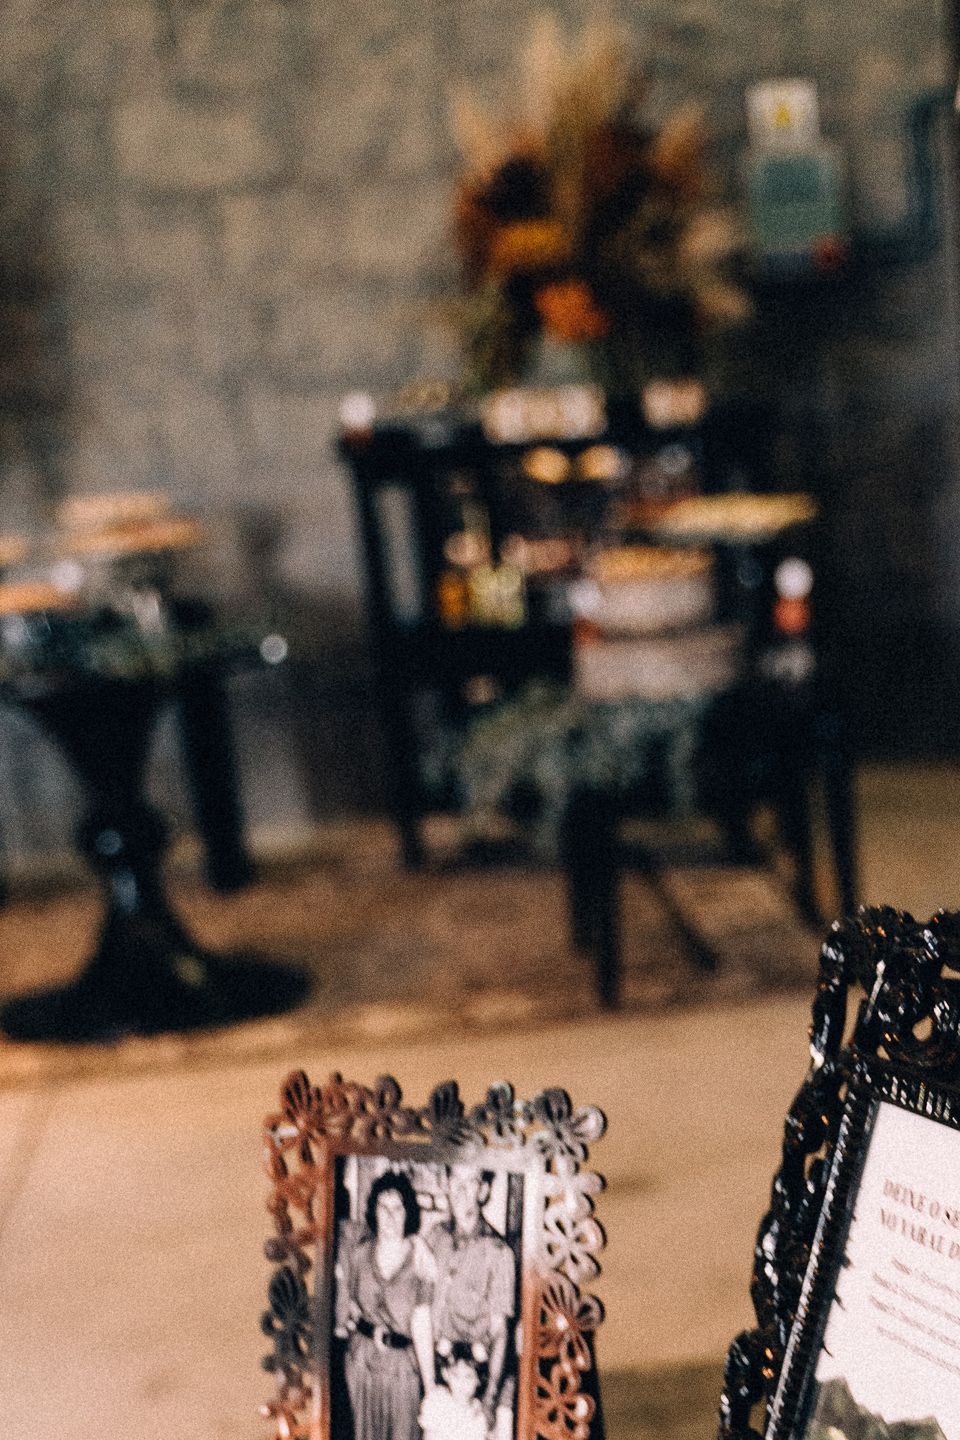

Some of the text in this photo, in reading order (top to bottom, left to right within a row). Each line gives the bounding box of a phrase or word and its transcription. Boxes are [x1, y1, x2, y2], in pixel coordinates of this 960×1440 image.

[883, 1178, 926, 1213] DEIXE
[929, 1200, 940, 1219] O
[901, 1218, 944, 1254] VARAL
